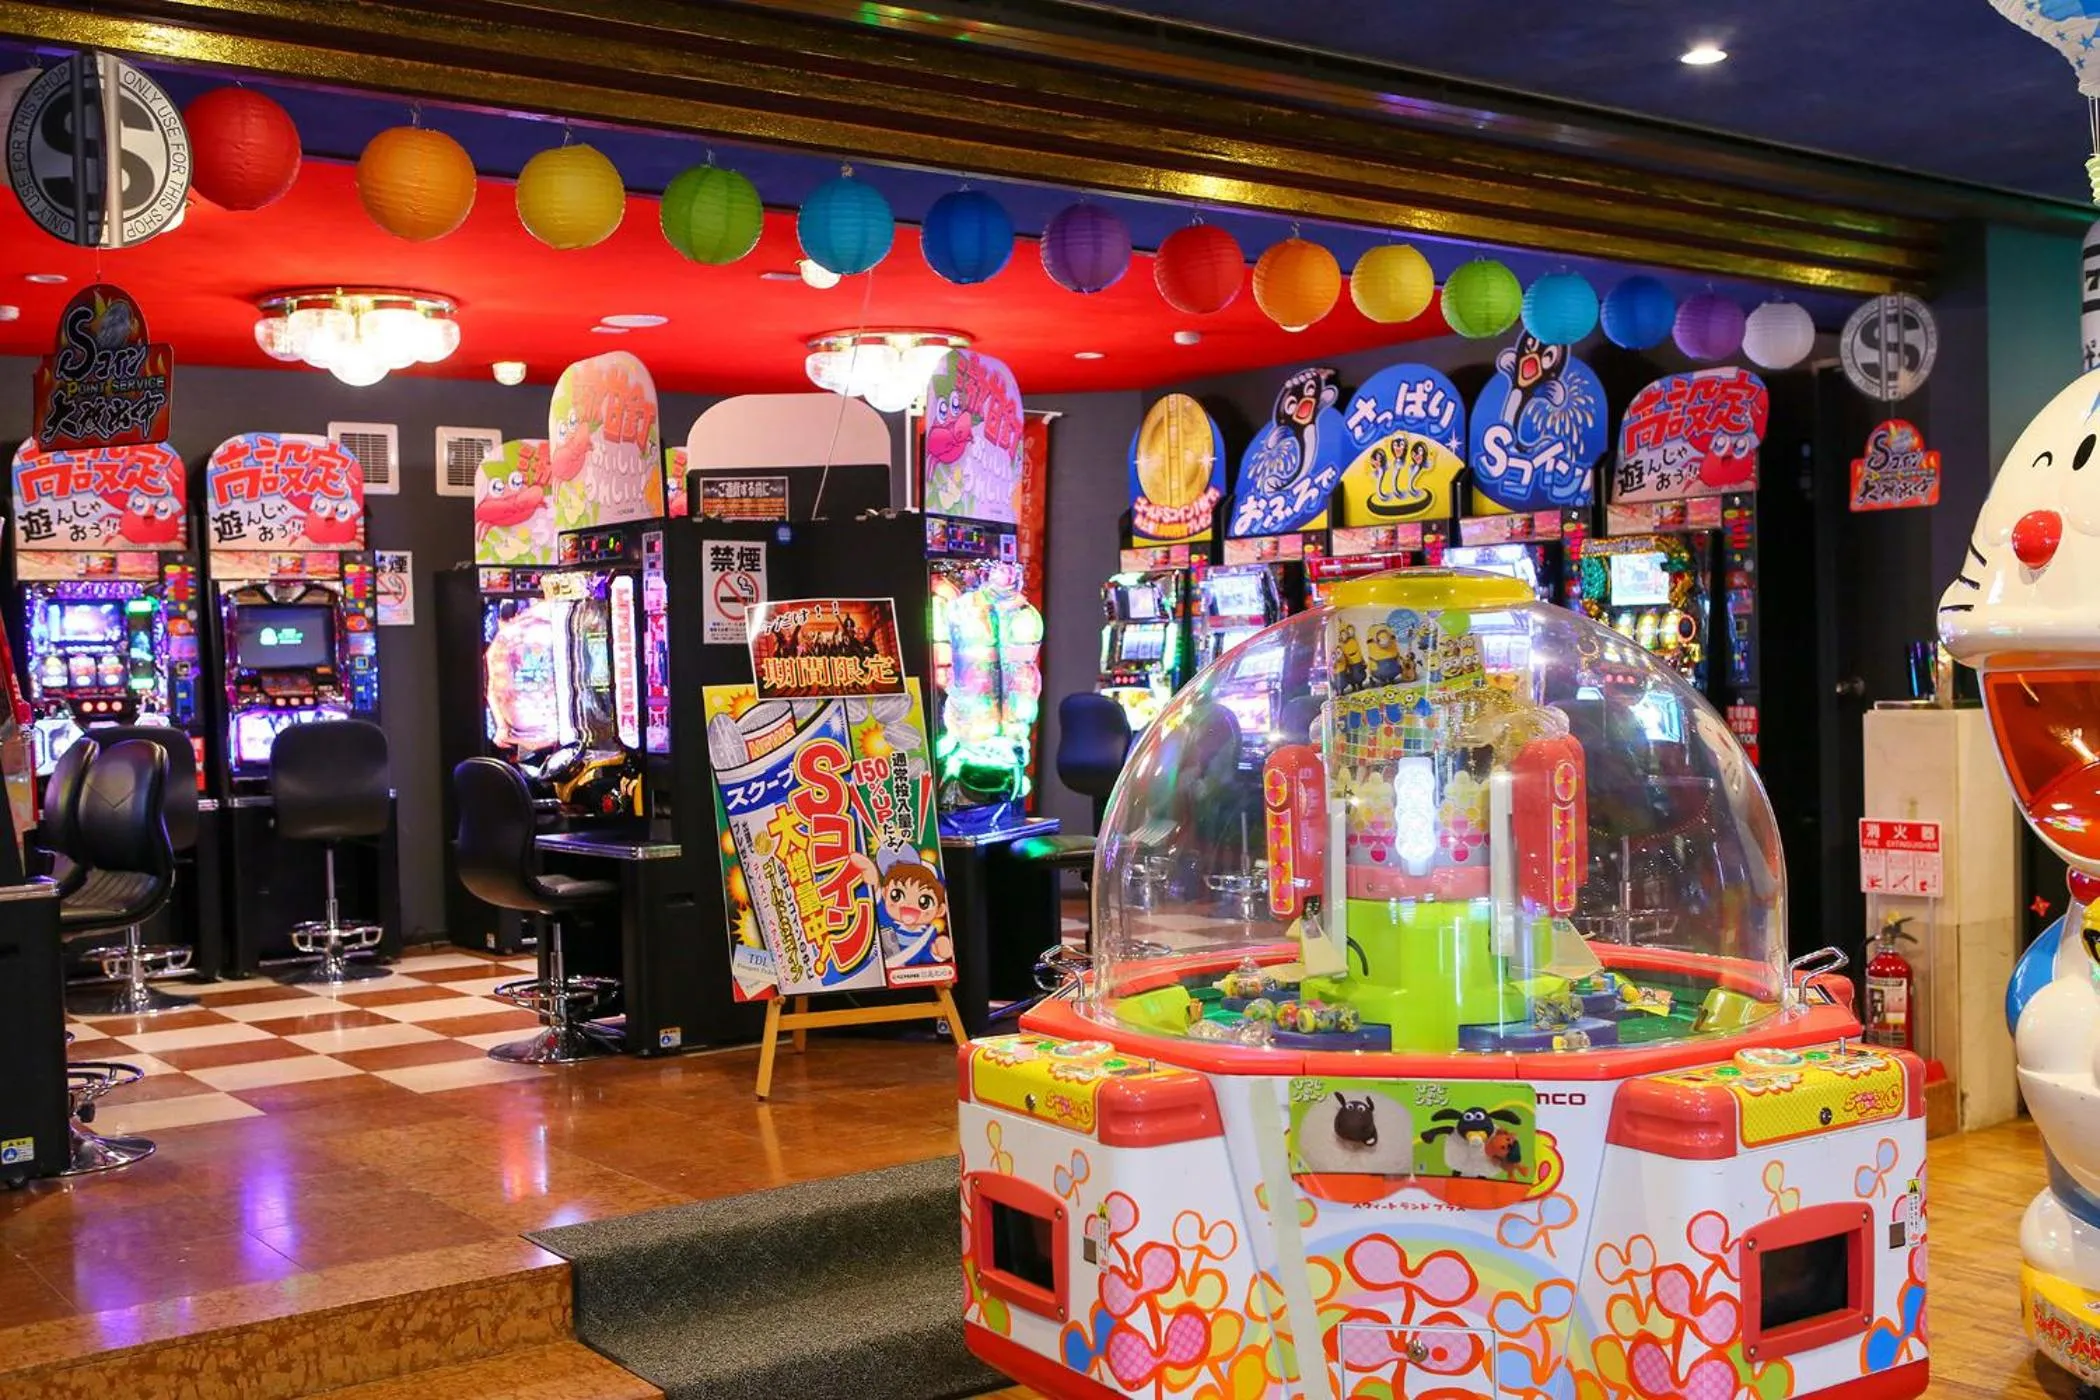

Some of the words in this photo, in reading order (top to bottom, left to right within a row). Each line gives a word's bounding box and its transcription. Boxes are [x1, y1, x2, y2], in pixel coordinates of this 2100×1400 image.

[32, 65, 69, 100] SHOP
[124, 70, 162, 104] ONLY
[13, 102, 37, 134] THIS
[157, 106, 178, 138] USE
[12, 139, 27, 174] FOR
[170, 142, 187, 176] FOR
[17, 174, 41, 208] USE
[161, 178, 185, 211] THIS
[37, 204, 71, 236] ONLY
[126, 210, 165, 239] SHOP
[111, 376, 165, 392] SERVICE
[1347, 379, 1456, 441] さっぱり
[1624, 369, 1760, 459] 高設定
[18, 443, 174, 506] 高設定
[212, 433, 352, 508] 高設定
[709, 545, 763, 574] 禁煙
[762, 653, 899, 689] 期間限定
[747, 718, 797, 761] NEWS
[727, 761, 795, 812] スクープ
[891, 751, 913, 839] 通常投入量の
[1866, 823, 1936, 842] 消火器
[787, 737, 877, 974] Sコイン
[1536, 1092, 1587, 1105] mco
